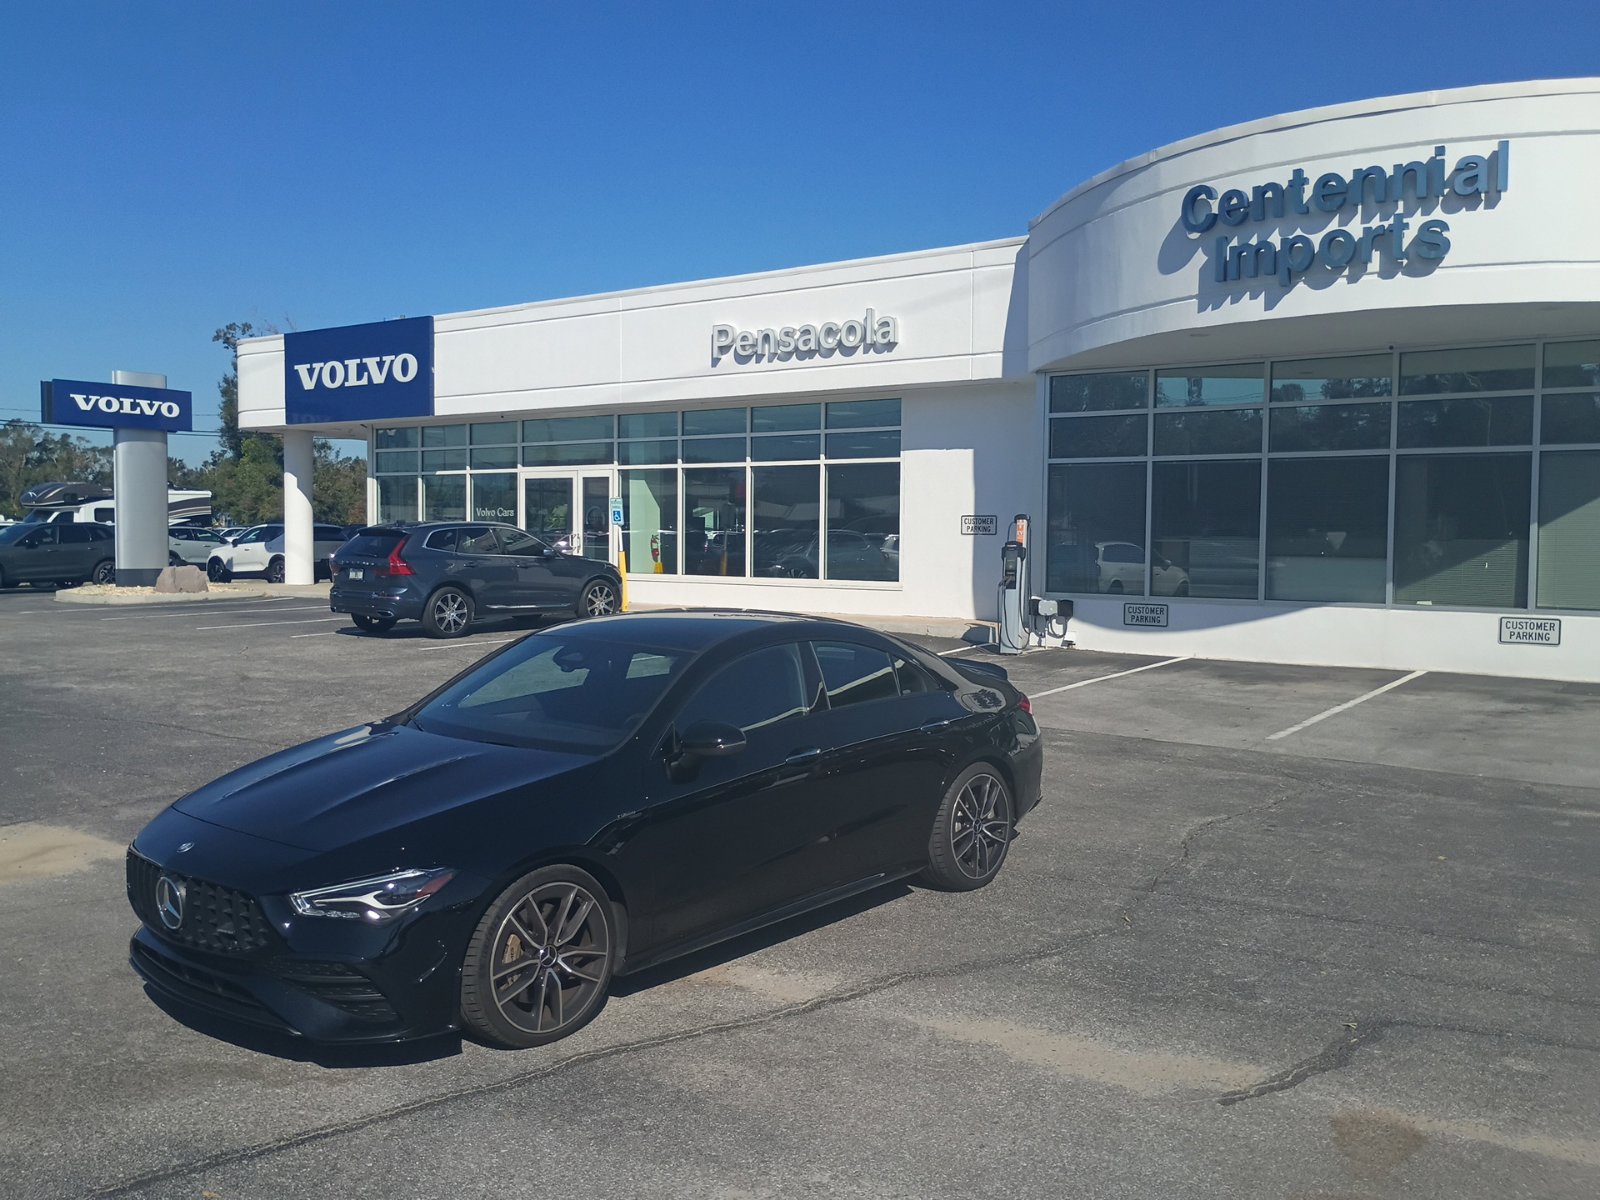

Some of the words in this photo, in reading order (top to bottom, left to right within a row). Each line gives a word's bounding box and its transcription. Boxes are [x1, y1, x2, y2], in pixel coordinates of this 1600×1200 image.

[1181, 140, 1510, 233] Centennial
[1215, 213, 1451, 286] Imports
[712, 308, 898, 359] Pensacola
[294, 353, 418, 390] VOLVO
[70, 394, 180, 418] VOLVO
[476, 507, 496, 517] Volvo
[497, 507, 515, 517] Cars
[1127, 606, 1165, 615] CUSTOMER
[1130, 614, 1161, 624] PARKING
[1505, 620, 1556, 632] CUSTOMER
[1509, 631, 1551, 642] PARKING
